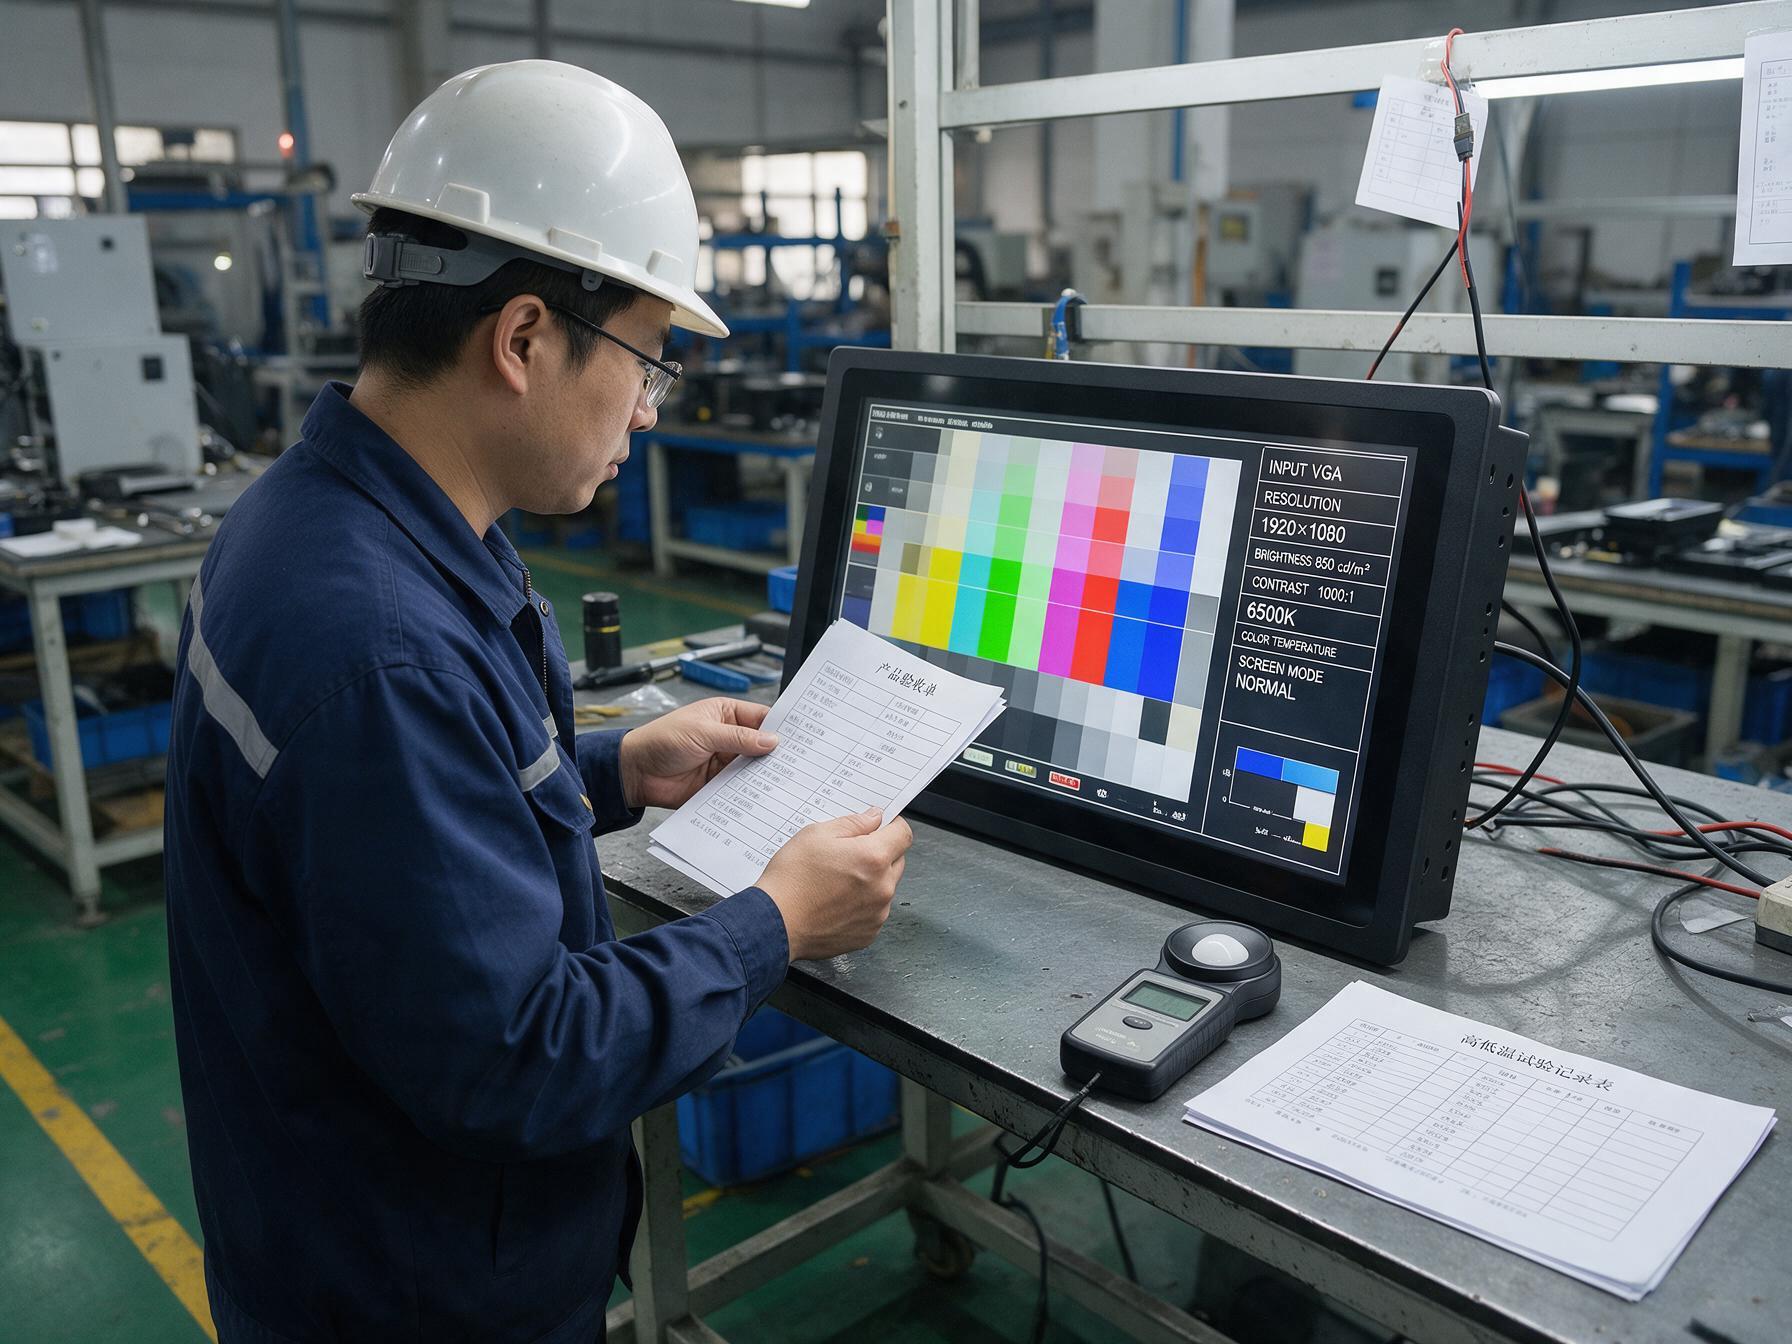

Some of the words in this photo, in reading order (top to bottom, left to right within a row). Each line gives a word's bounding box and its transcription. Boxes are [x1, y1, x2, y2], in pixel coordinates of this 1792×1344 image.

[1269, 460, 1308, 477] INPUT
[1312, 464, 1343, 482] VGA
[1264, 491, 1342, 512] RESOLUTION
[1254, 548, 1312, 566] BRIGHTNESS
[1315, 556, 1335, 571] 850
[1252, 576, 1309, 596] CONTRAST
[1318, 586, 1354, 604] 1000:1
[1247, 602, 1297, 627] 6500K
[1241, 631, 1270, 645] COLOR
[1272, 635, 1337, 658] TEMPERATURE
[875, 661, 938, 697] 产品验收单
[1238, 655, 1285, 675] SCREEN
[1287, 665, 1324, 683] MODE
[1235, 673, 1296, 700] NORMAL
[1461, 1034, 1614, 1092] 高低温试验记录表
